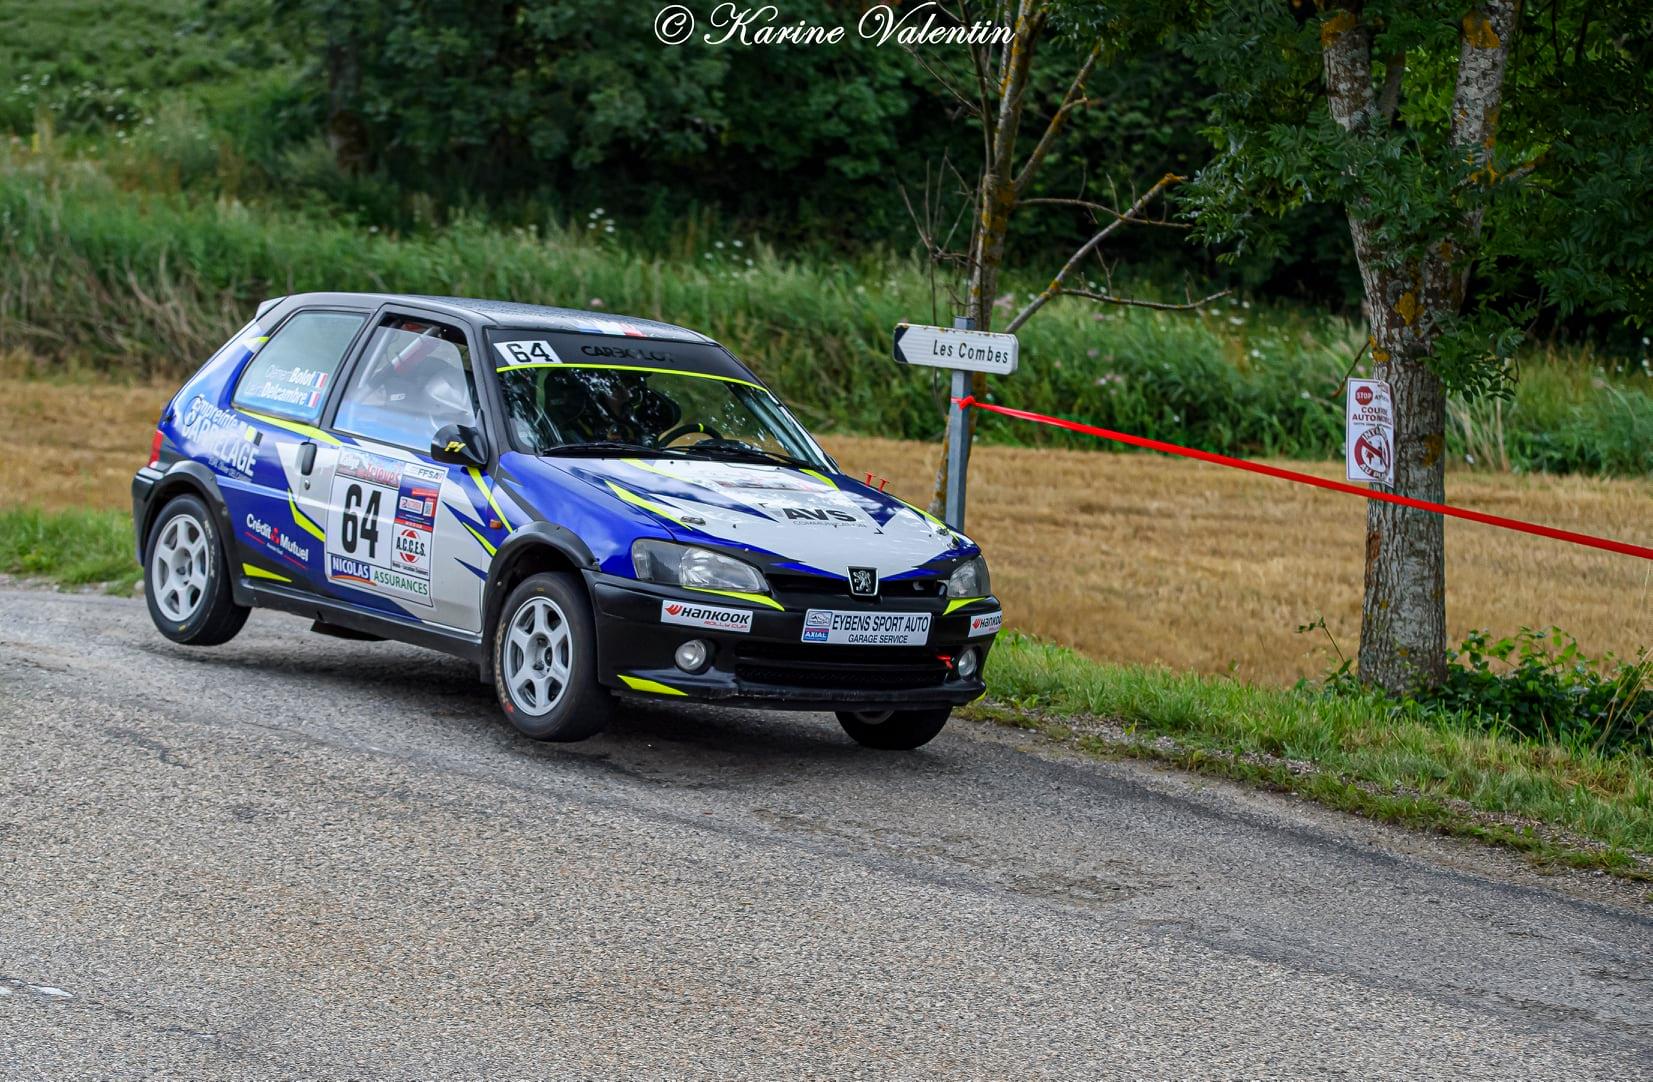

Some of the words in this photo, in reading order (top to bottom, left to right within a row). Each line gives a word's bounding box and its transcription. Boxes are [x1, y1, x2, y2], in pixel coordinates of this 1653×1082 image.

[506, 342, 554, 363] 64
[933, 339, 954, 357] Les
[958, 342, 1009, 364] Combes
[1356, 391, 1373, 400] STOP
[418, 468, 439, 480] FFSA
[341, 483, 382, 559] 64
[782, 508, 857, 522] AVS
[246, 513, 272, 539] Crédit
[280, 533, 309, 562] Mutuel
[396, 536, 426, 557] A.C.C.E.S.
[332, 557, 369, 579] NICOLAS
[373, 570, 429, 596] ASSURANCES
[832, 614, 871, 631] EYBENS
[872, 615, 905, 632] SPORT
[904, 617, 930, 633] AUTO
[848, 634, 878, 643] GARAGE
[879, 635, 909, 644] SERVICE
